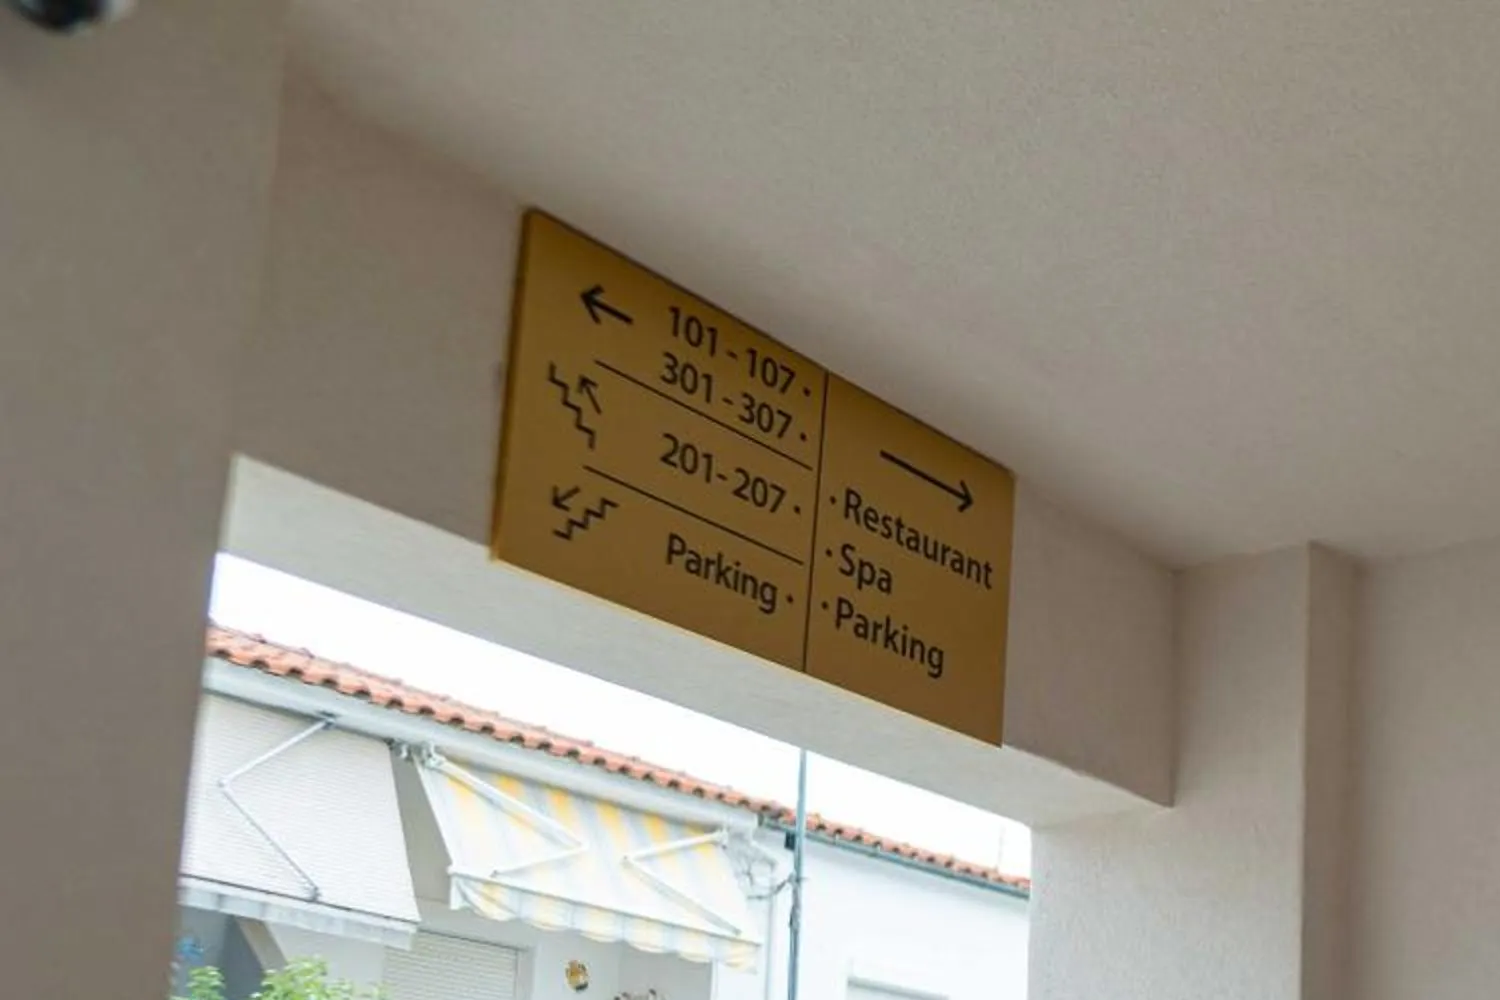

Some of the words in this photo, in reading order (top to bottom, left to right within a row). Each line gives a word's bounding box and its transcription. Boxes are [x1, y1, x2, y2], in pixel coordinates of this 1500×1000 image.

[667, 532, 778, 615] Parking
[838, 544, 894, 595] Spa
[844, 488, 994, 591] Restaurant
[835, 597, 945, 679] Parking
